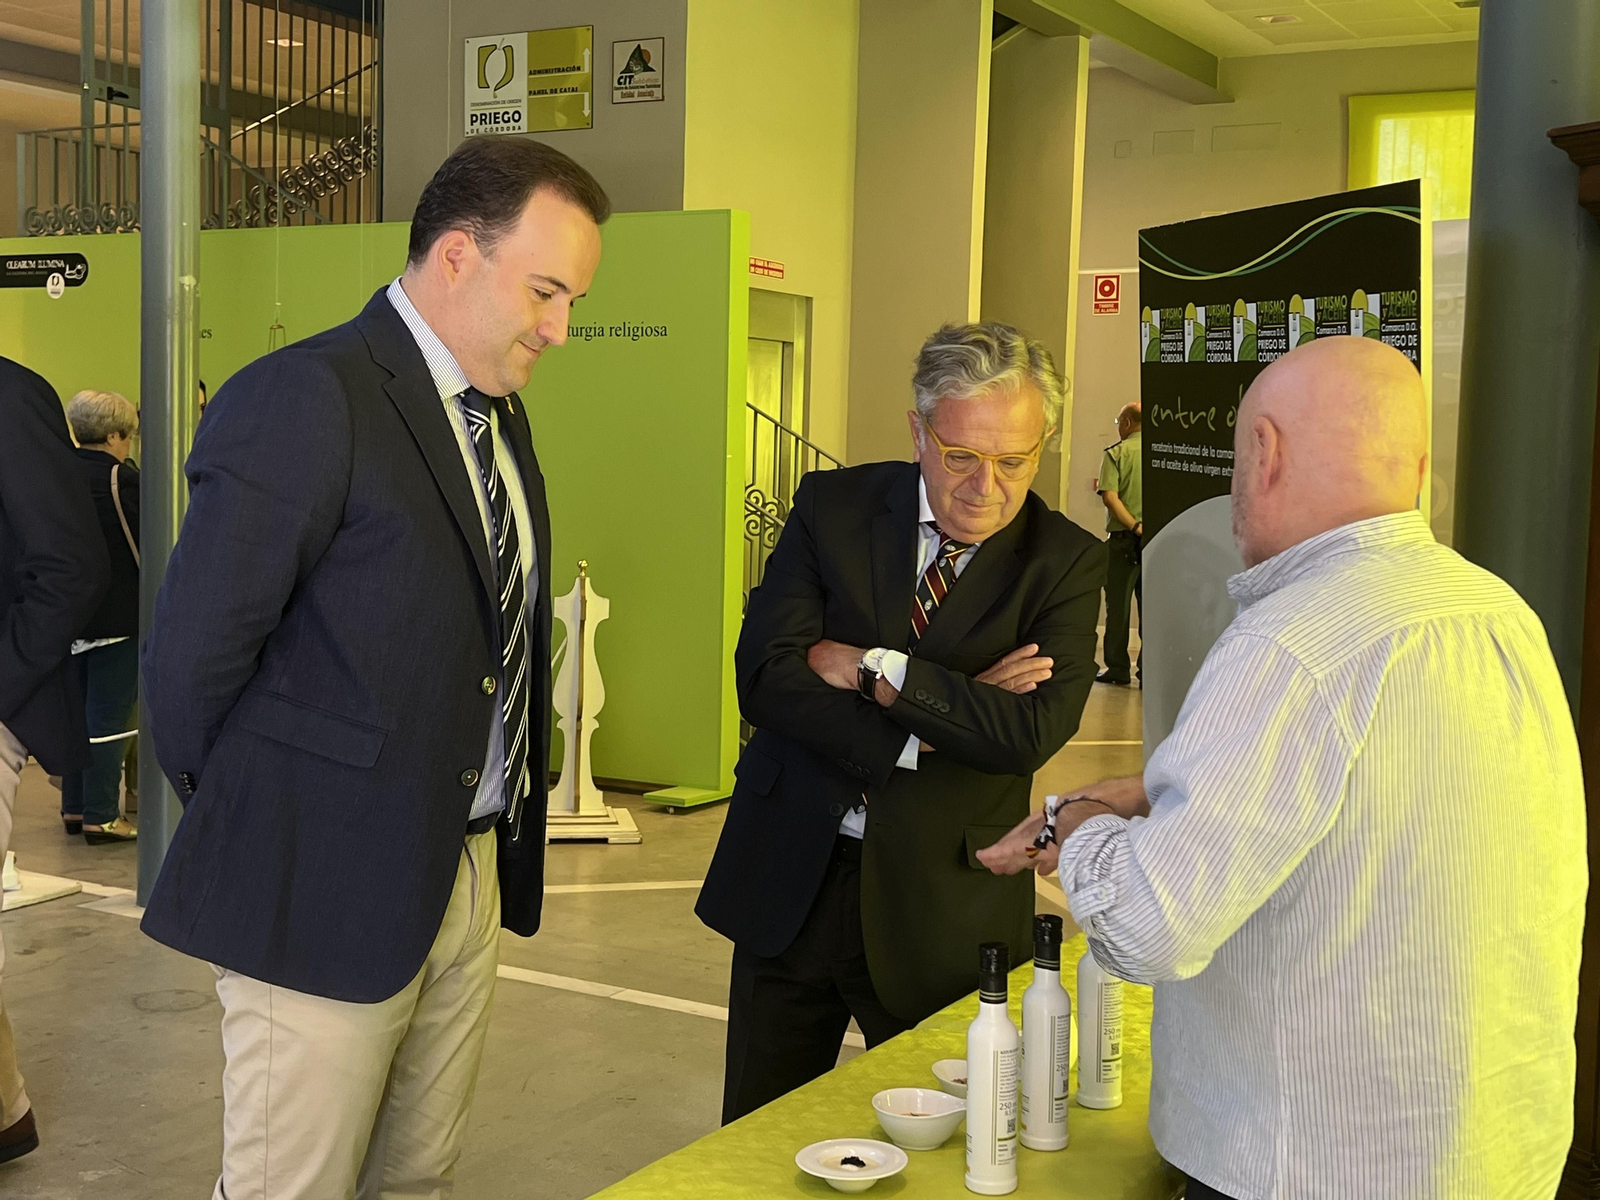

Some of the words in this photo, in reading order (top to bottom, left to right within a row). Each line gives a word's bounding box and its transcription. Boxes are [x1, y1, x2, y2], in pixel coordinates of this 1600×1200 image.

[617, 75, 634, 85] CIT
[470, 110, 522, 126] PRIEGO
[1316, 295, 1348, 309] TURISMO
[1381, 289, 1417, 305] TURISMO
[1161, 307, 1183, 319] TURISMO
[1206, 304, 1231, 317] TURISMO
[1257, 300, 1285, 313] TURISMO
[609, 321, 668, 342] religiosa
[1177, 341, 1183, 351] DE
[1206, 340, 1224, 351] PRIEGO
[1225, 340, 1232, 350] DE
[1258, 339, 1278, 349] PRIEGO
[1279, 339, 1286, 349] DE
[1408, 335, 1417, 346] DE
[1161, 351, 1183, 363] CÓRDOBA
[1206, 350, 1232, 363] CÓRDOBA
[1151, 396, 1216, 431] entre
[1151, 442, 1173, 453] recetario
[1173, 443, 1200, 456] tradicional
[1202, 445, 1209, 457] de
[1210, 446, 1215, 457] la
[1151, 459, 1160, 468] con
[1161, 457, 1166, 468] el
[1166, 460, 1181, 471] aceite
[1182, 460, 1189, 472] de
[1190, 461, 1203, 474] oliva
[1204, 464, 1221, 477] virgen
[1104, 1028, 1115, 1036] 250
[1000, 1101, 1012, 1110] 250
